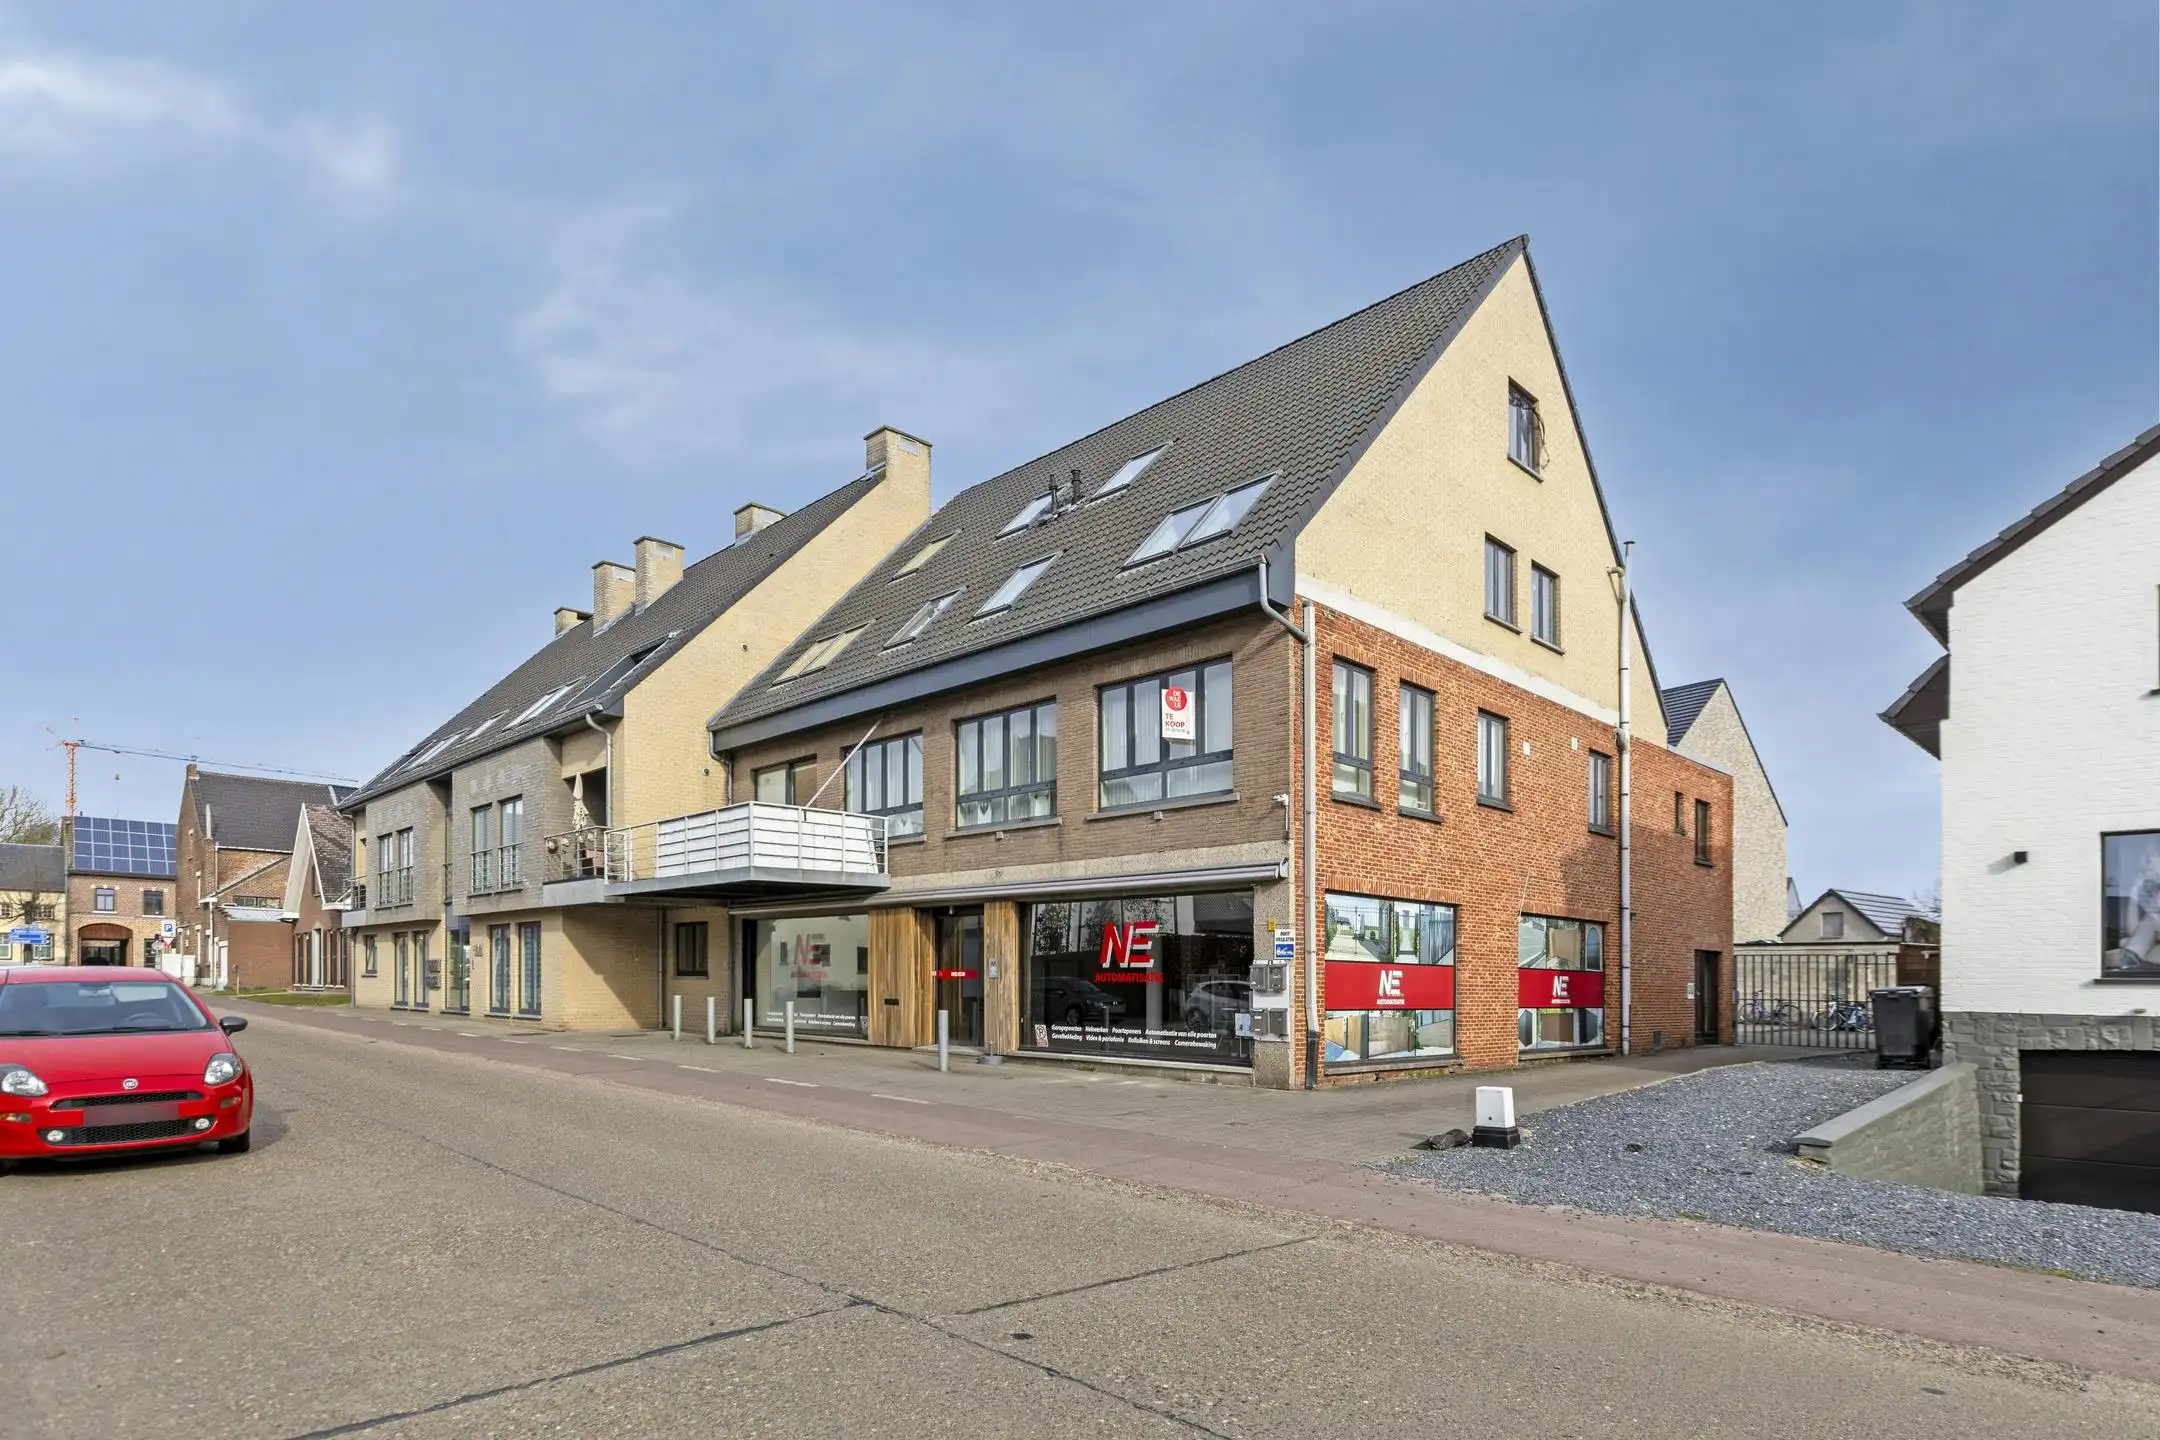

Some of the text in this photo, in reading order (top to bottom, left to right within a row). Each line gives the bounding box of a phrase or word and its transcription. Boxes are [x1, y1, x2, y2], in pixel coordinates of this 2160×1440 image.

[1100, 919, 1160, 968] NE
[1379, 969, 1403, 996] NE
[1553, 975, 1569, 997] NE
[1145, 1028, 1177, 1036] Automatisatie
[1196, 1031, 1217, 1039] poorten
[1174, 1039, 1217, 1050] Camerabewaking
